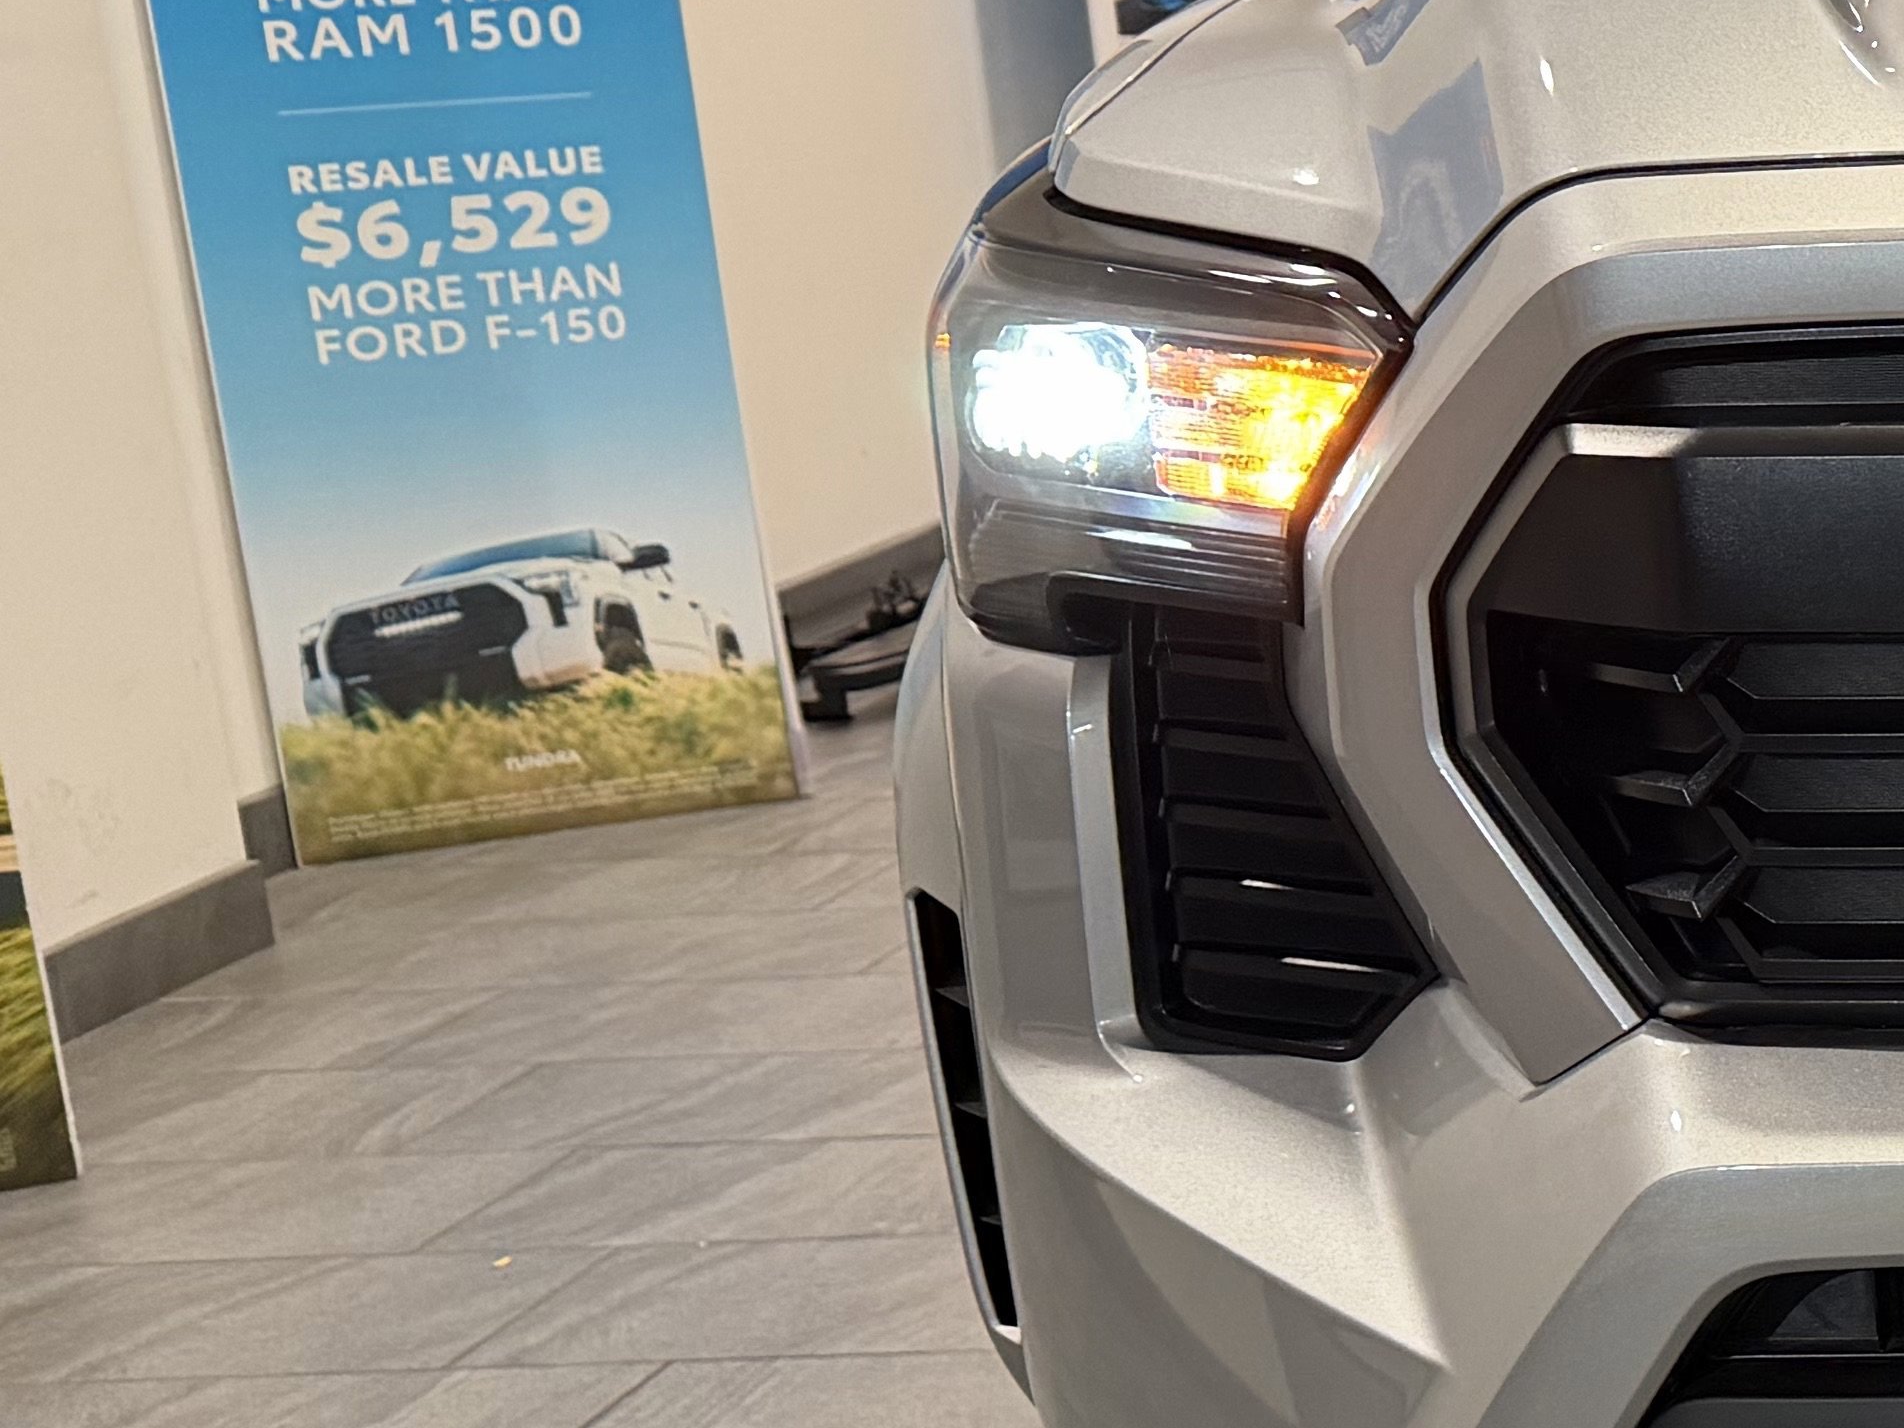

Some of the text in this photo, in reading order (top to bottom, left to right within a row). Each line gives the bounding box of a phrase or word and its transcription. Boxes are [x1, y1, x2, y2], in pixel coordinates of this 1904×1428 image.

[262, 4, 583, 62] RAM 1500
[287, 145, 604, 194] RESALE VALUE
[296, 186, 612, 268] $6,529
[308, 262, 622, 321] MORE THAN
[314, 304, 627, 365] FORD F-150
[367, 592, 460, 625] TOYOTA
